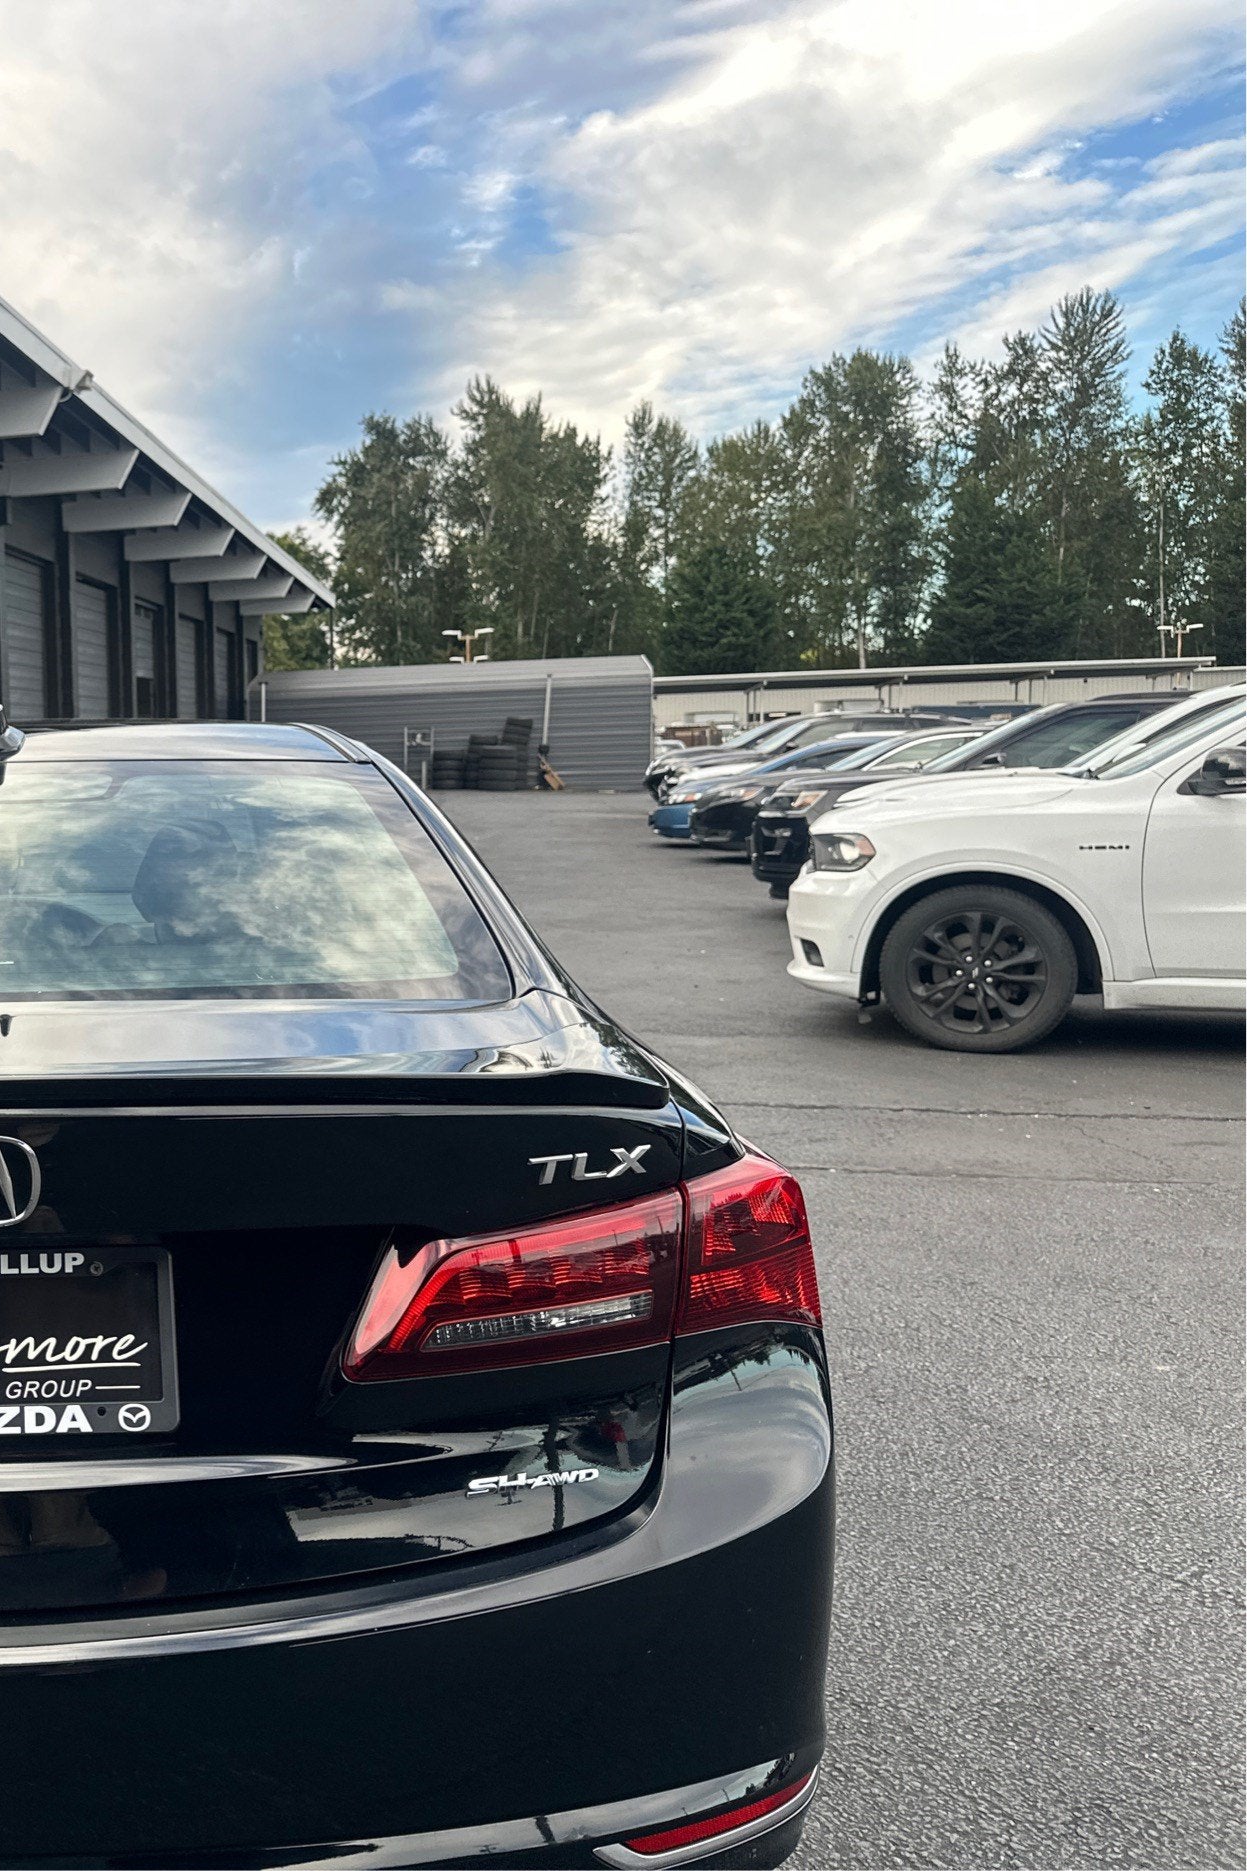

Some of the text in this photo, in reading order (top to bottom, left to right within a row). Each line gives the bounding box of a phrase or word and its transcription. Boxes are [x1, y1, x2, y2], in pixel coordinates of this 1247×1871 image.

[528, 1144, 651, 1185] TLX
[5, 1379, 92, 1400] GROUP
[466, 1468, 600, 1497] SH-AWD
